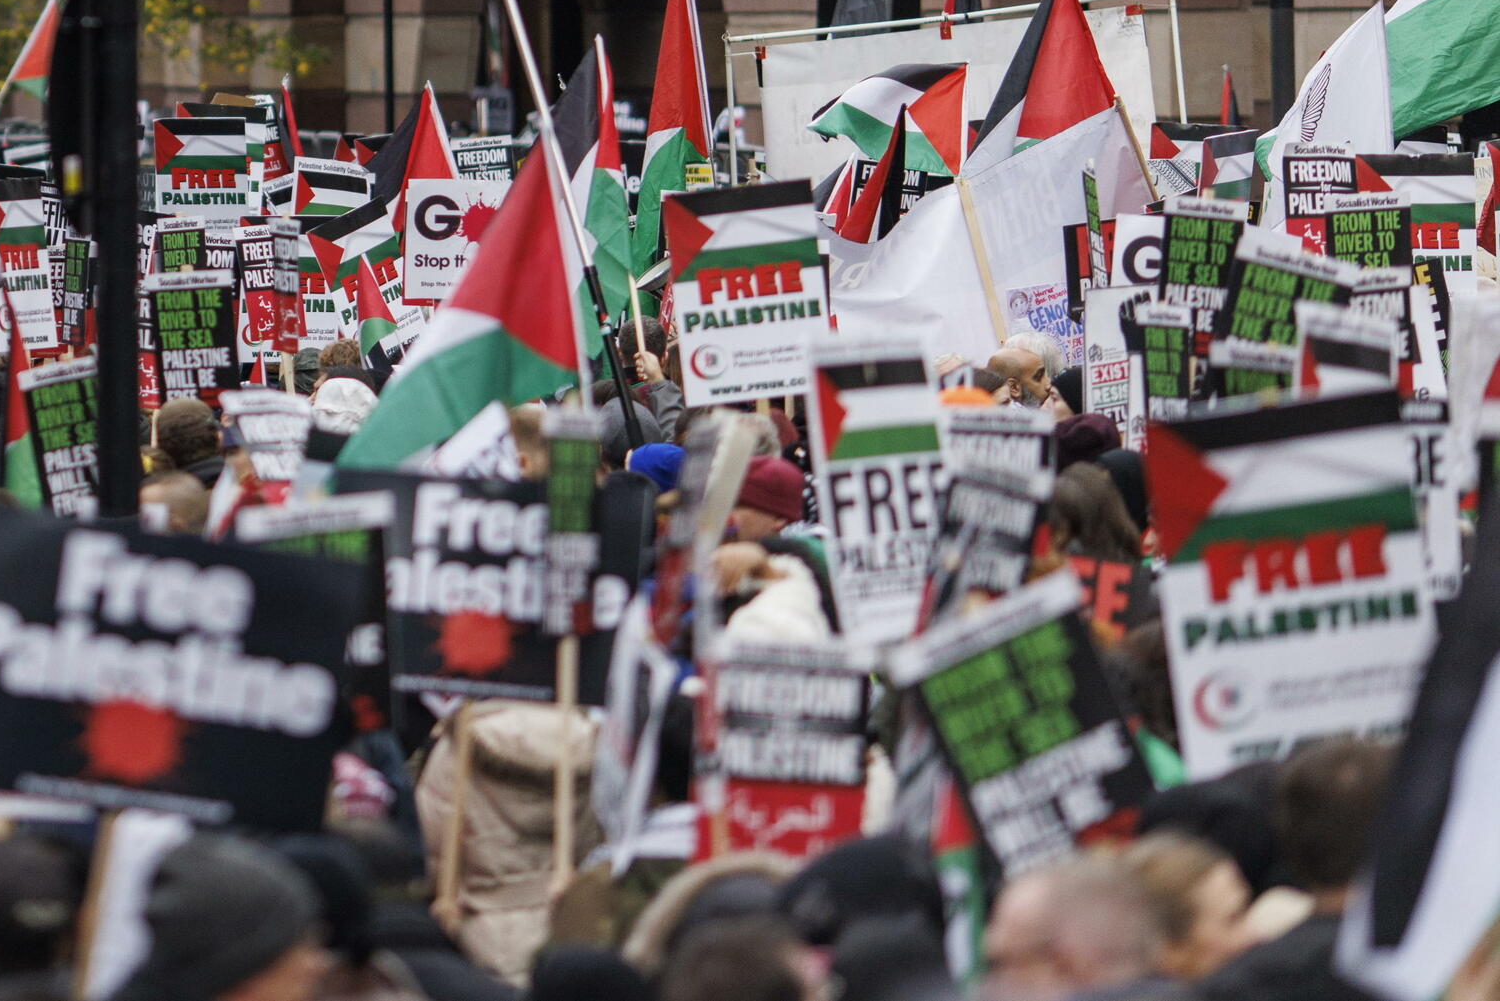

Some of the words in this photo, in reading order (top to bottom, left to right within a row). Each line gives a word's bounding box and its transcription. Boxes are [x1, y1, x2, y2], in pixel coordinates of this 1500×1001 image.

[457, 148, 507, 166] FREEDOM
[1294, 145, 1323, 154] Socialist
[1324, 146, 1346, 154] Worker
[171, 168, 236, 189] FREE
[299, 162, 322, 171] Palestine
[323, 164, 346, 174] Solidarity
[1289, 161, 1352, 183] FREEDOM
[1321, 182, 1332, 192] for
[162, 192, 246, 205] PALESTINE
[1335, 199, 1367, 208] Socialist
[1368, 197, 1399, 206] Worker
[1171, 217, 1208, 238] FROM
[1212, 221, 1236, 243] THE
[1333, 213, 1371, 234] FROM
[1375, 210, 1401, 230] THE
[163, 232, 185, 249] FROM
[186, 231, 200, 247] THE
[1334, 232, 1373, 253] RIVER
[1376, 233, 1395, 250] TO
[0, 244, 40, 271] FREE
[164, 249, 186, 267] RIVER
[187, 248, 198, 264] TO
[414, 254, 450, 270] Stop
[1169, 239, 1207, 263] RIVER
[1210, 242, 1227, 265] TO
[1364, 253, 1390, 269] SEA
[696, 260, 803, 305] FREE
[1168, 262, 1191, 283] THE
[1194, 264, 1218, 286] SEA
[156, 290, 193, 309] FROM
[195, 288, 222, 307] THE
[1165, 283, 1228, 310] PALESTIN
[158, 310, 198, 330] RIVER
[201, 309, 218, 328] TO
[684, 299, 821, 333] PALESTINE
[160, 330, 186, 349] THE
[187, 330, 214, 348] SEA
[163, 348, 231, 368] PALESTINE
[164, 370, 195, 389] WILL
[201, 368, 216, 387] BE
[1092, 367, 1128, 381] EXIST
[1093, 385, 1128, 402] RESIS
[1204, 522, 1387, 606] FREE
[53, 529, 255, 635] Free
[1182, 589, 1419, 653] PALESTINE
